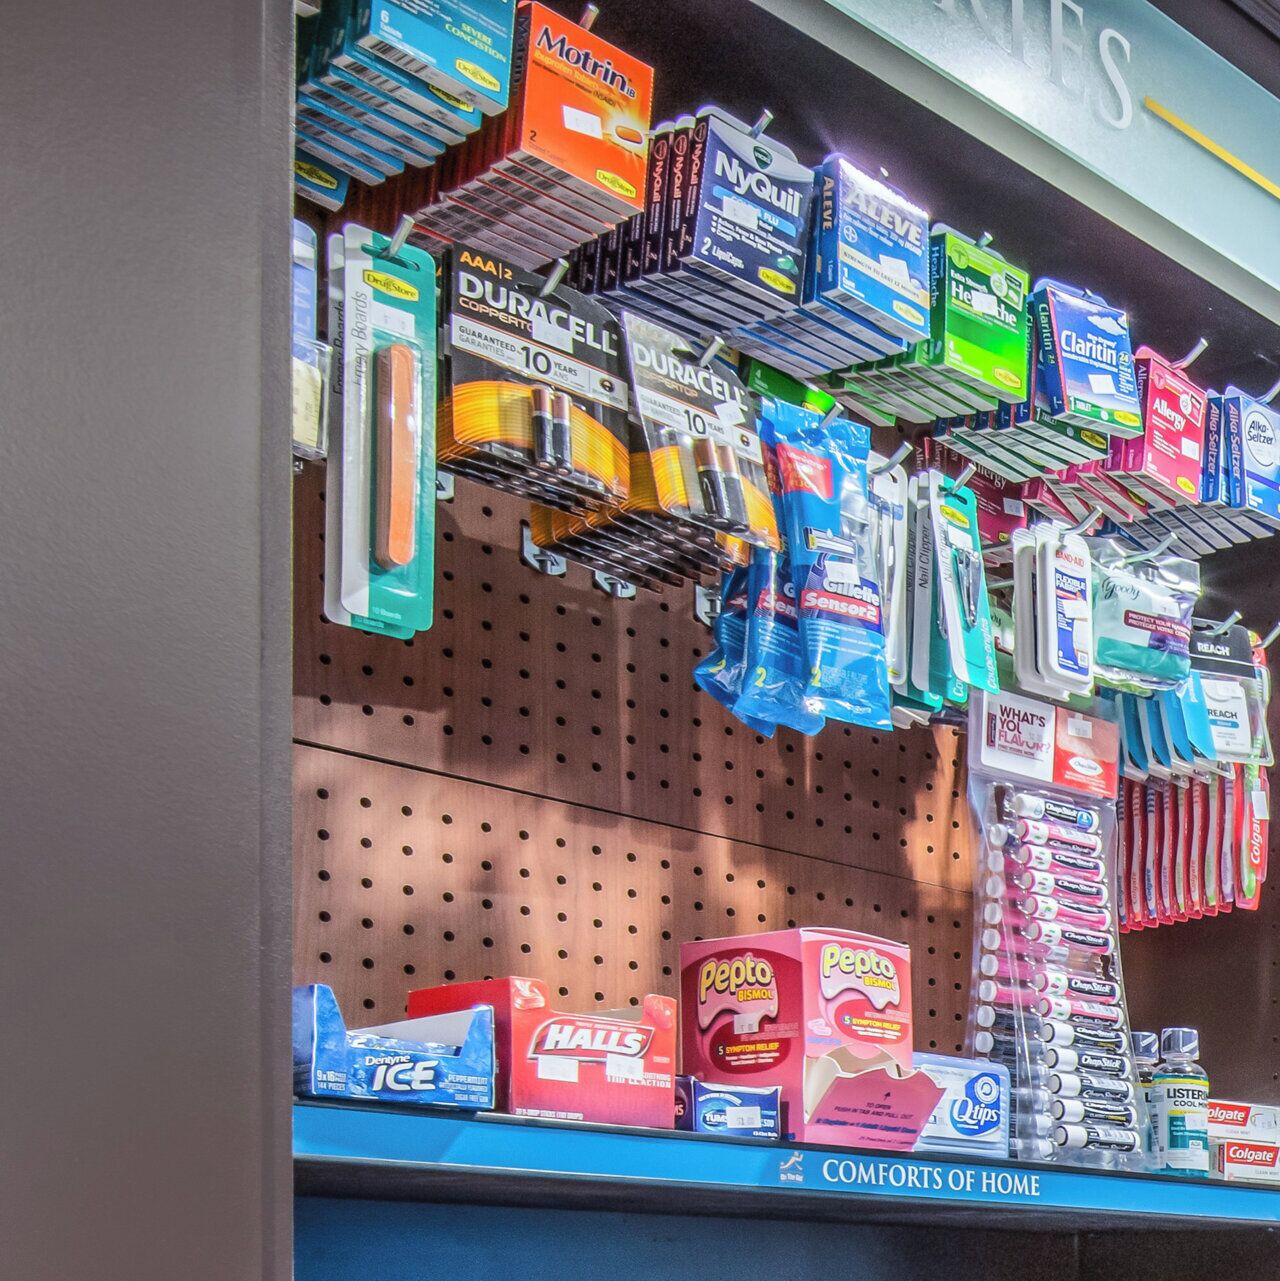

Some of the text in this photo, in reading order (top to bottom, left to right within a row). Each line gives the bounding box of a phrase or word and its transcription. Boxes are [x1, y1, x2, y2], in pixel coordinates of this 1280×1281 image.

[444, 23, 508, 64] CONGESTION
[461, 22, 493, 46] SEVERE
[537, 26, 637, 99] Motrin IB
[529, 129, 538, 142] 2
[673, 156, 687, 200] NyQuil
[689, 144, 704, 186] NyQuil
[653, 161, 668, 203] NyQuil
[714, 150, 805, 218] NyQuil
[822, 176, 836, 231] ALEVE
[848, 188, 923, 248] ALEVE
[459, 250, 513, 280] AAA 2
[931, 245, 941, 309] Headache
[365, 272, 419, 302] DrugStore
[459, 271, 619, 357] DURACELL
[1040, 303, 1054, 352] Claritin
[459, 325, 517, 353] GUARANTEED
[521, 345, 552, 377] 10
[553, 361, 578, 377] YEARS
[1153, 397, 1188, 433] Allergy
[1251, 419, 1271, 438] Alka-
[1209, 402, 1221, 473] Alka-Seltzer
[1229, 403, 1242, 477] Alka-Seltzer
[1247, 431, 1275, 451] Seltzer
[805, 592, 881, 627] Sensor2
[1197, 647, 1231, 657] REACH
[1000, 704, 1047, 729] WHAT'S
[1207, 708, 1239, 720] REACH
[701, 956, 774, 1004] Pepto
[823, 944, 897, 986] Pepto
[738, 987, 775, 1003] BISMOL
[864, 976, 897, 991] BISMOL
[1071, 979, 1112, 994] ChapStick
[543, 1023, 647, 1056] HALLS
[719, 1043, 780, 1056] 5 SYMPTOM RELIEF
[366, 1054, 411, 1068] Dentyne
[373, 1060, 440, 1092] ICE
[1081, 1055, 1122, 1070] ChapStick
[949, 1090, 1001, 1126] Q-tips
[1228, 1145, 1274, 1164] Colgate
[822, 1159, 1040, 1196] COMFORTS OF HOME
